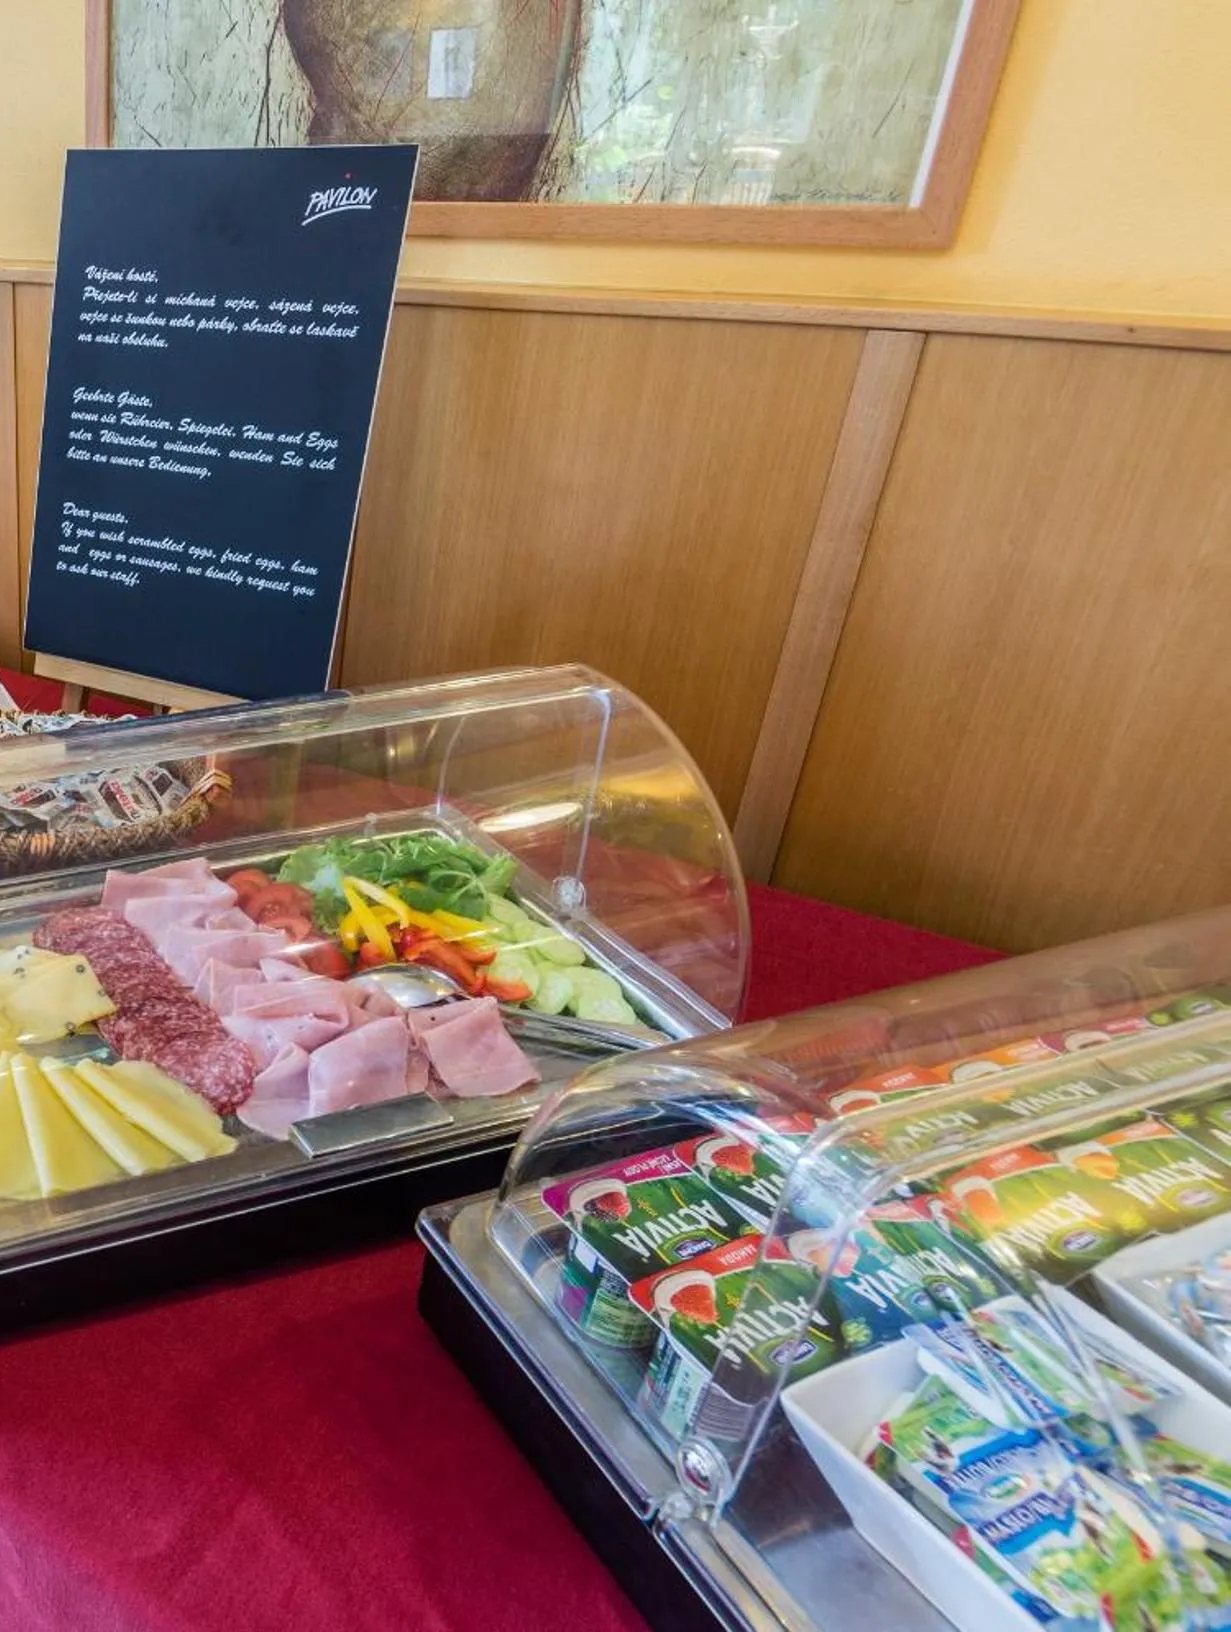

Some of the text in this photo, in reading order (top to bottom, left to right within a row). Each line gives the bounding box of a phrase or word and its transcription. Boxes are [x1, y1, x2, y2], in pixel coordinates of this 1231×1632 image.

[304, 186, 378, 216] PAVILON
[145, 293, 158, 304] si
[78, 333, 92, 342] na
[79, 310, 108, 325] vejce
[110, 313, 123, 323] se
[169, 314, 195, 328] nebo
[289, 324, 304, 335] se
[69, 428, 93, 441] oder
[228, 449, 274, 463] wenden
[280, 450, 304, 467] Sie
[309, 456, 337, 470] sich
[71, 411, 99, 421] wenn
[100, 413, 117, 424] sie
[242, 424, 274, 442] Ham
[277, 432, 305, 444] and
[305, 431, 339, 452] Eggs
[66, 446, 91, 461] bitte
[92, 453, 107, 463] an
[109, 455, 146, 468] unsere
[63, 502, 90, 518] Dear
[61, 520, 74, 538] If
[76, 528, 96, 539] you
[99, 530, 125, 542] wish
[127, 536, 186, 552] scrambled
[220, 548, 252, 564] fried
[290, 559, 318, 576] ham
[56, 560, 67, 571] to
[68, 563, 89, 575] ask
[90, 568, 109, 578] our
[58, 543, 80, 554] and
[89, 549, 112, 562] eggs
[115, 553, 127, 562] or
[186, 566, 202, 576] we
[204, 565, 244, 586] kindly
[247, 576, 290, 592] request
[292, 585, 316, 597] you
[1111, 1157, 1224, 1208] ACTIVIA
[612, 1199, 728, 1258] ACTIVIA
[704, 1296, 830, 1363] ACTIVIA
